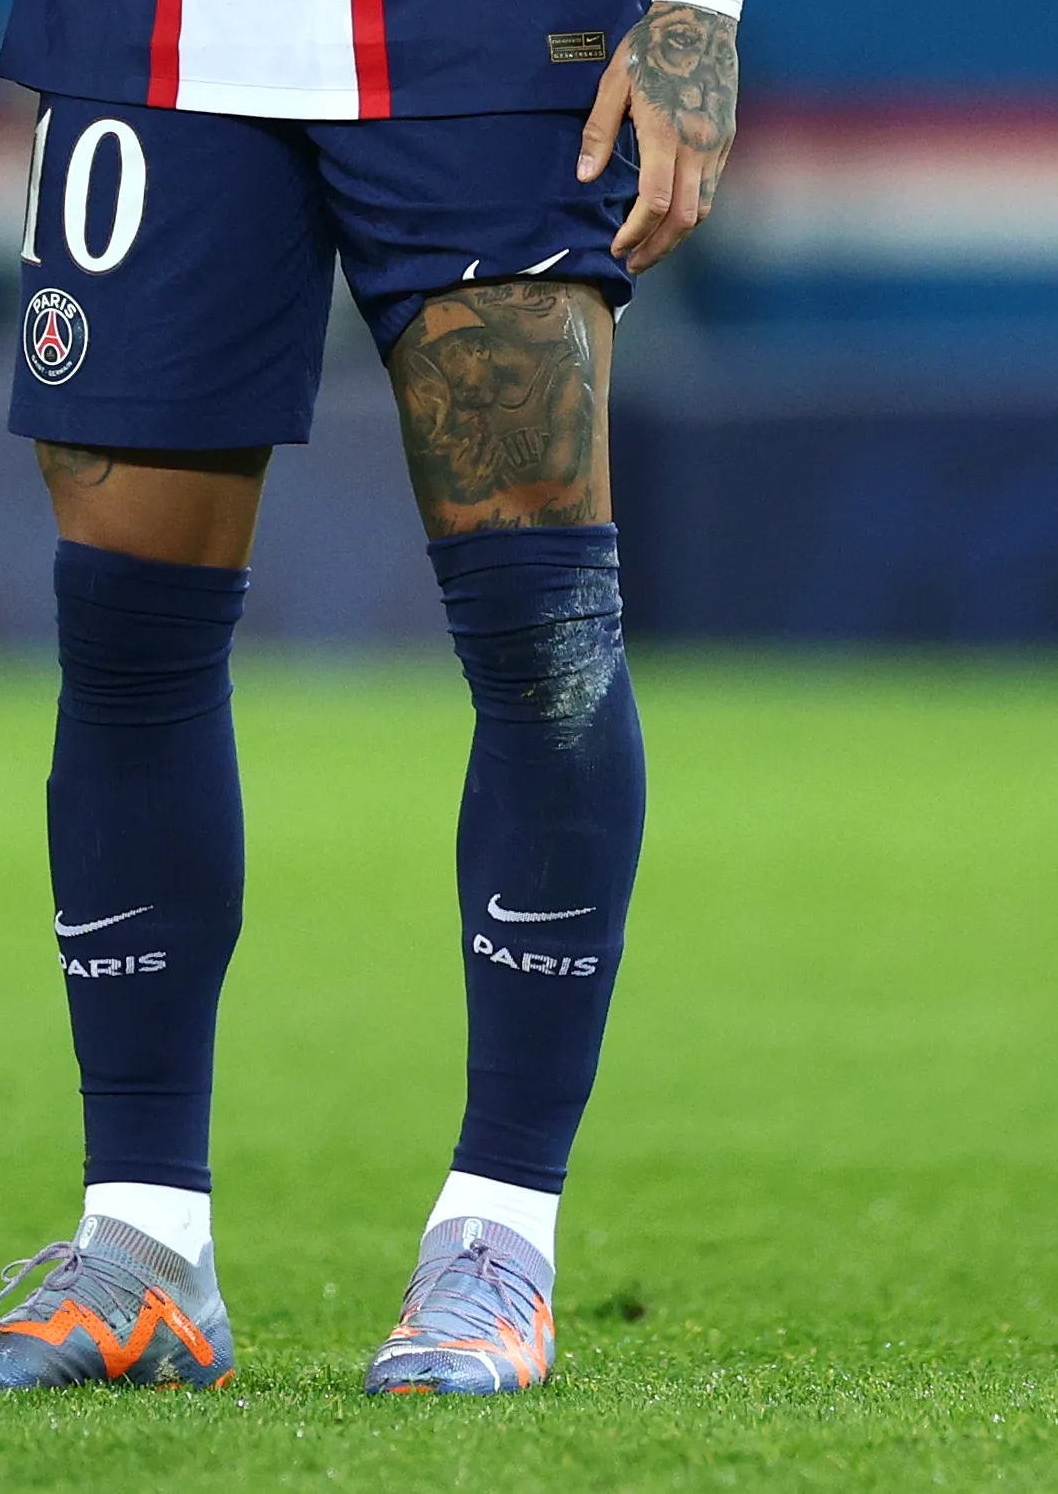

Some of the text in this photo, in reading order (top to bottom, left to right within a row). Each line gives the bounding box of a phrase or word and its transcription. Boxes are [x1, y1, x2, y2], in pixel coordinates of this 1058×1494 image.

[21, 107, 148, 276] 10
[32, 292, 78, 320] PARIS
[472, 932, 600, 977] PARIS
